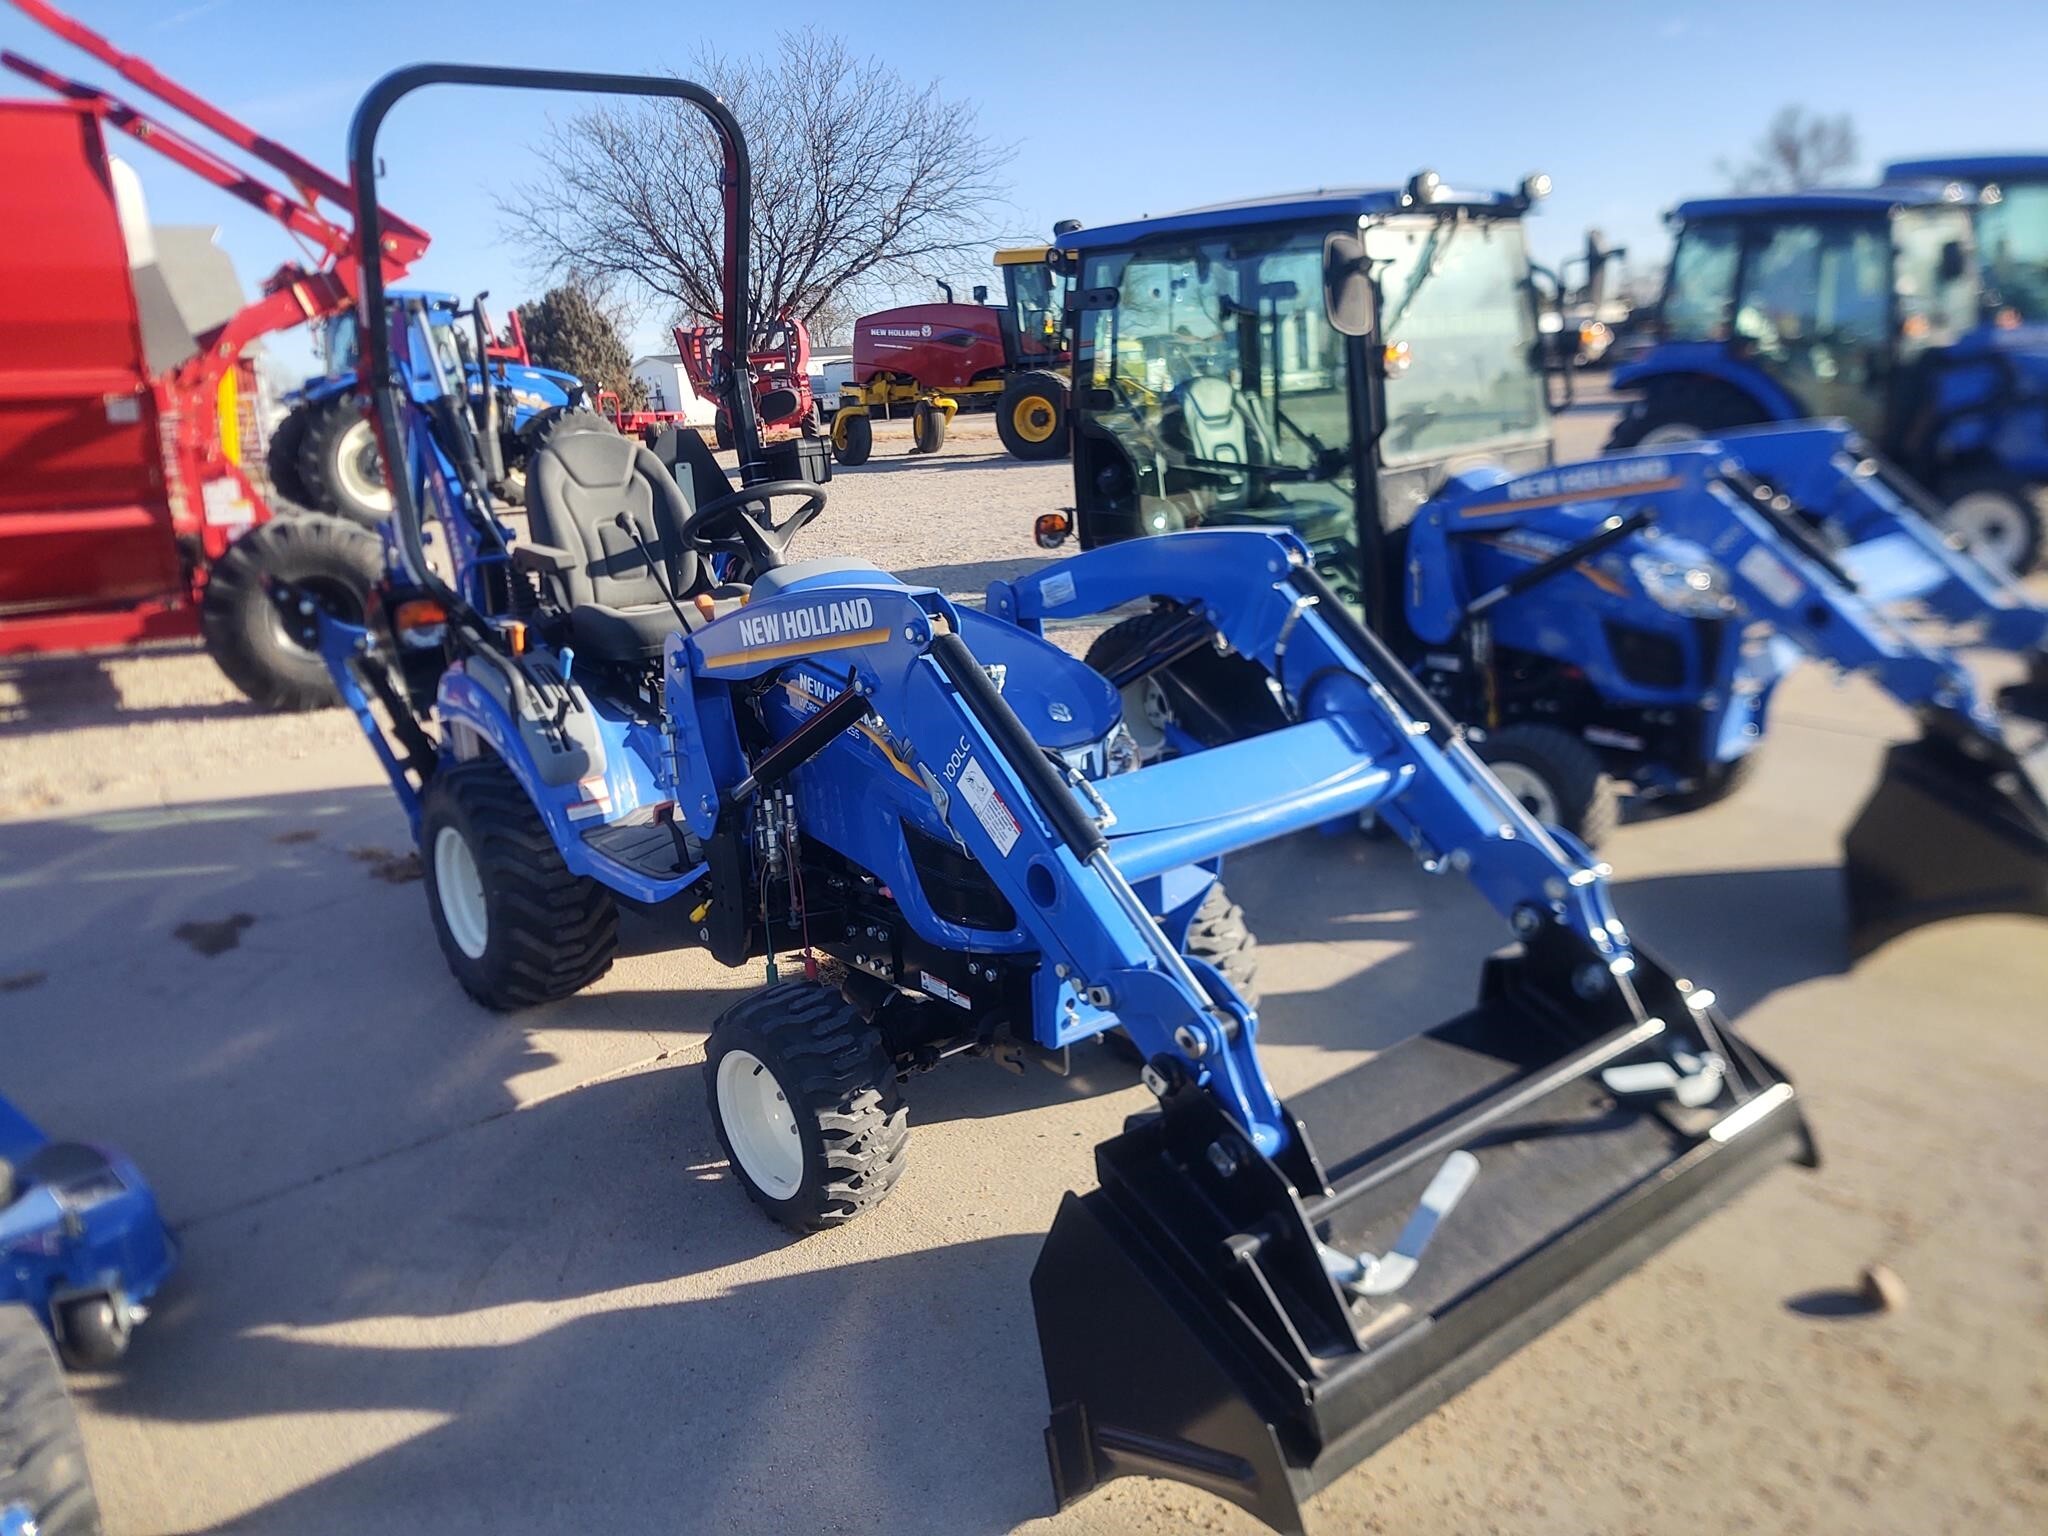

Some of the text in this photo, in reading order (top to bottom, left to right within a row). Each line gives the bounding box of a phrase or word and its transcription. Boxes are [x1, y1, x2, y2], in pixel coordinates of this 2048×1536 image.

[870, 328, 920, 337] NEW HOLLAND
[738, 597, 874, 647] NEW HOLLAND
[799, 672, 825, 699] NEW
[942, 735, 970, 782] 100LC
